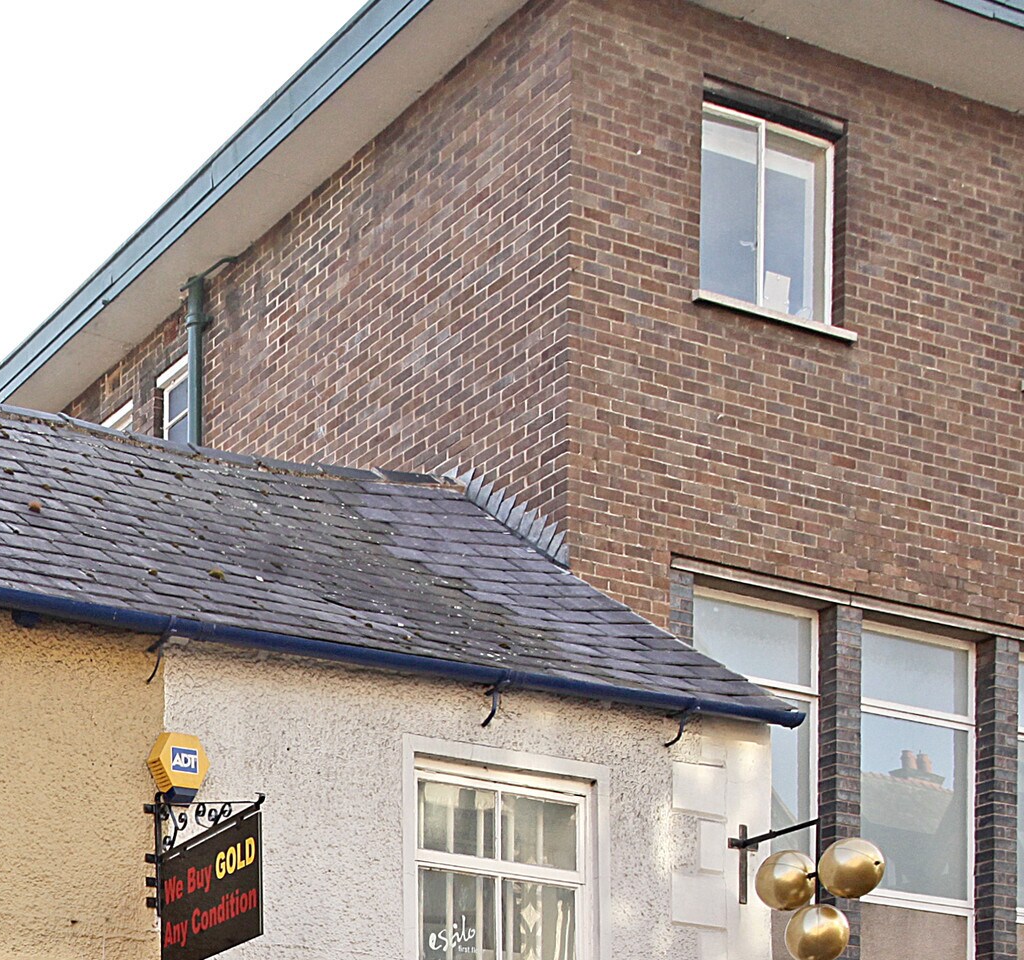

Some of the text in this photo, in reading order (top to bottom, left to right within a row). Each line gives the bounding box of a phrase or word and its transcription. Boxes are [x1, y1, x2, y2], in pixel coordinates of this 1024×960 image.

[171, 750, 198, 769] ADT
[164, 836, 255, 904] We Buy GOLD
[163, 888, 257, 948] Any Condition
